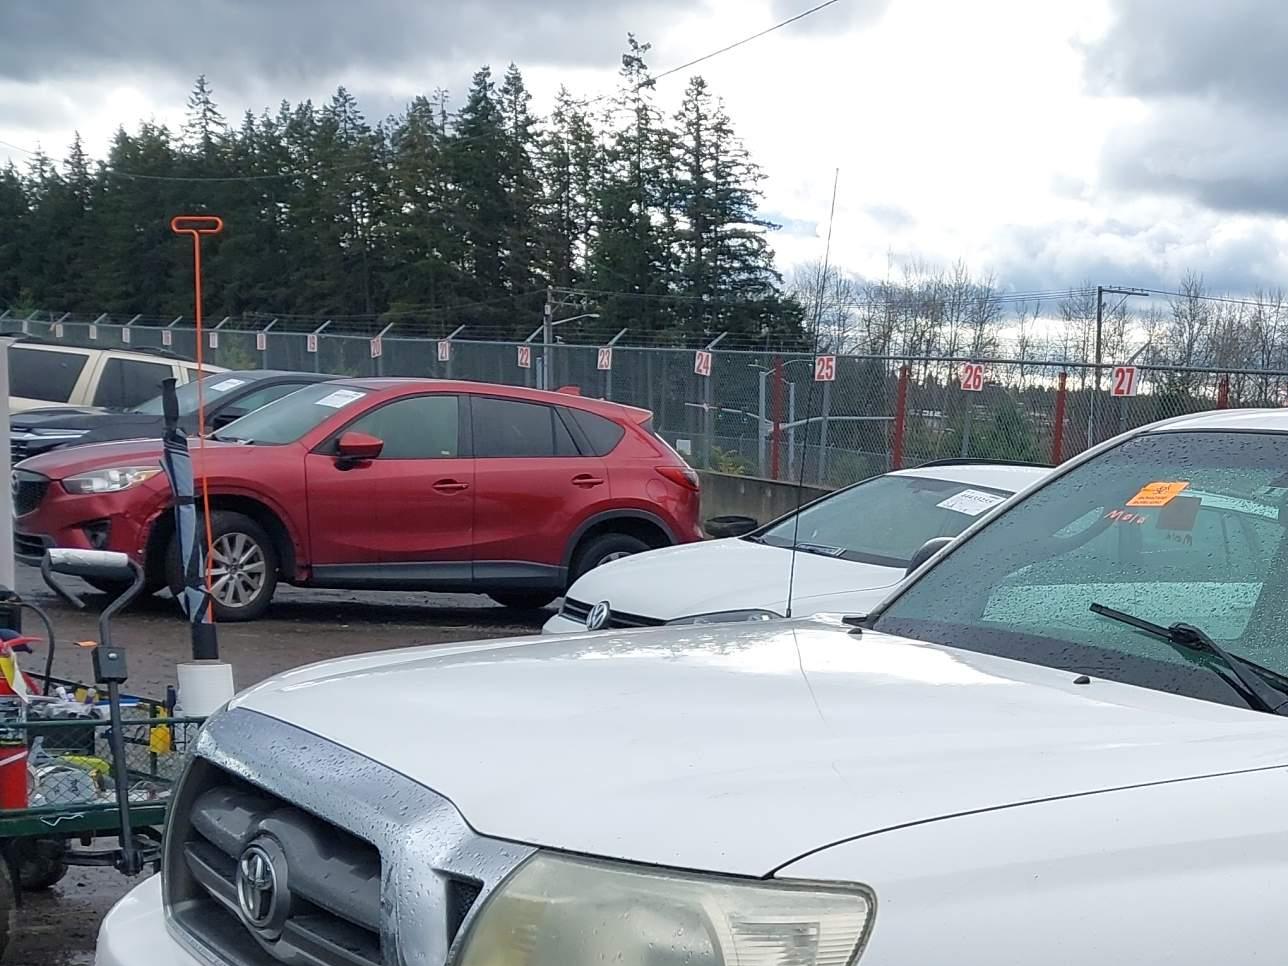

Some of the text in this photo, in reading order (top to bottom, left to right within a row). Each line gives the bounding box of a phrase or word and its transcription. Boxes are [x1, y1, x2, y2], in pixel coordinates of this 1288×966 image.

[519, 347, 529, 366] 22
[599, 349, 610, 368] 23
[696, 352, 710, 375] 24
[816, 357, 834, 380] 25
[962, 364, 982, 389] 26
[1113, 367, 1135, 395] 27
